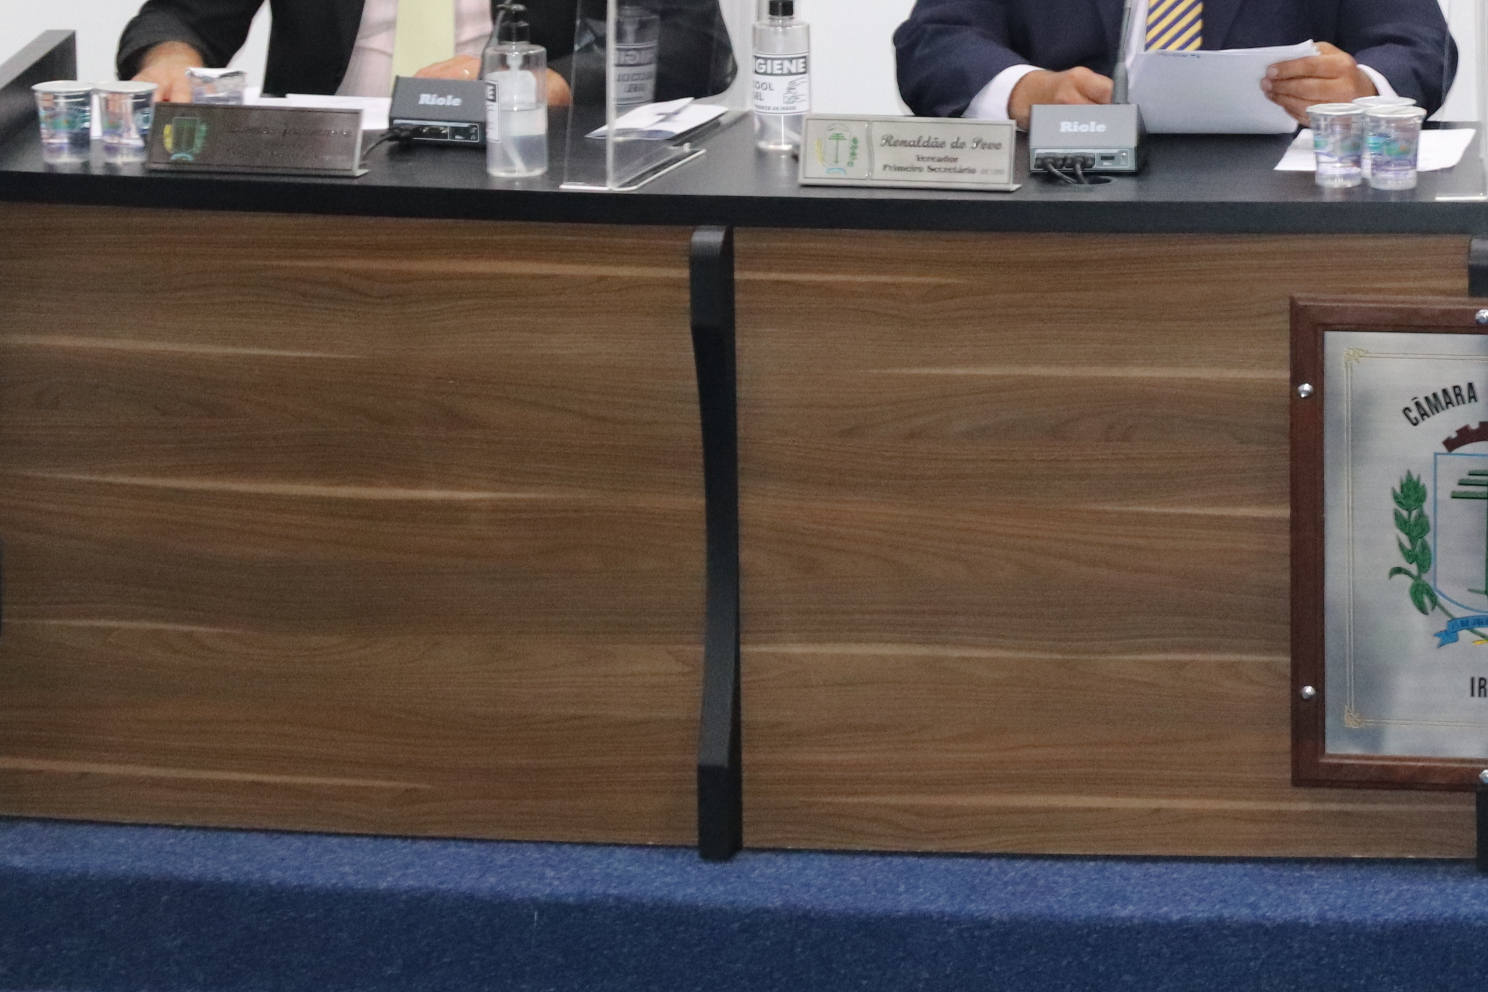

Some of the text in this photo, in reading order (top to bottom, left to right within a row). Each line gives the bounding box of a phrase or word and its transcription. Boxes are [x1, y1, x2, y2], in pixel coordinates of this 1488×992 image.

[418, 93, 463, 107] Riole
[1060, 121, 1107, 133] Riole
[1402, 381, 1479, 427] CÂMARA
